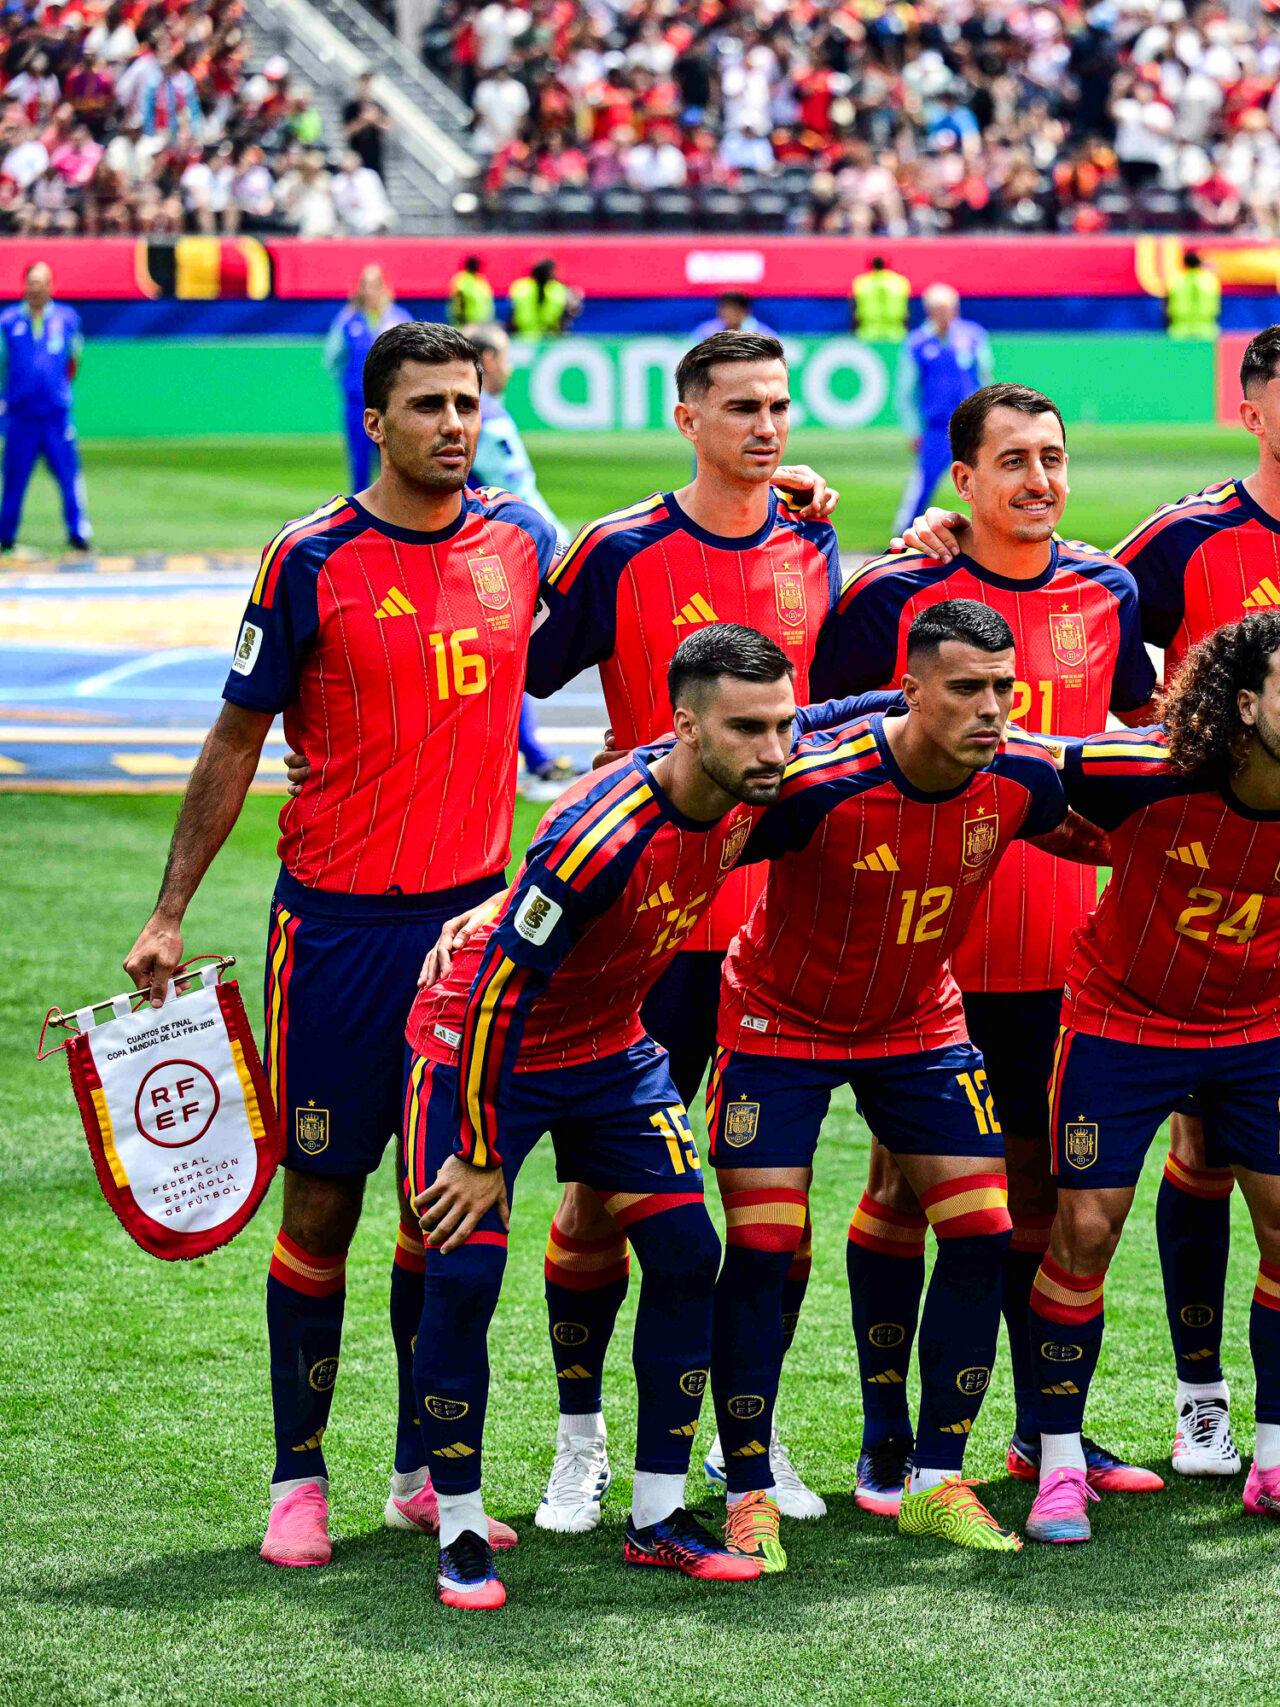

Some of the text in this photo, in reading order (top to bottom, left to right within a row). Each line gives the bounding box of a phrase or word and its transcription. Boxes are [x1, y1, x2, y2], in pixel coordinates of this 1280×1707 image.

[430, 628, 487, 700] 16
[896, 886, 953, 945] 12
[1175, 887, 1264, 944] 24
[107, 1019, 215, 1061] COPA MUNDIAL DE LA FIFA 2026
[127, 1018, 192, 1045] CUARTOS DE FINAL
[956, 1069, 1002, 1135] 12
[649, 1104, 702, 1175] 15
[152, 1158, 239, 1194] FEDERACIÓN
[173, 1156, 209, 1173] REAL
[164, 1173, 234, 1204] ESPAÑOLA
[165, 1184, 241, 1217] DE FÚTBOL
